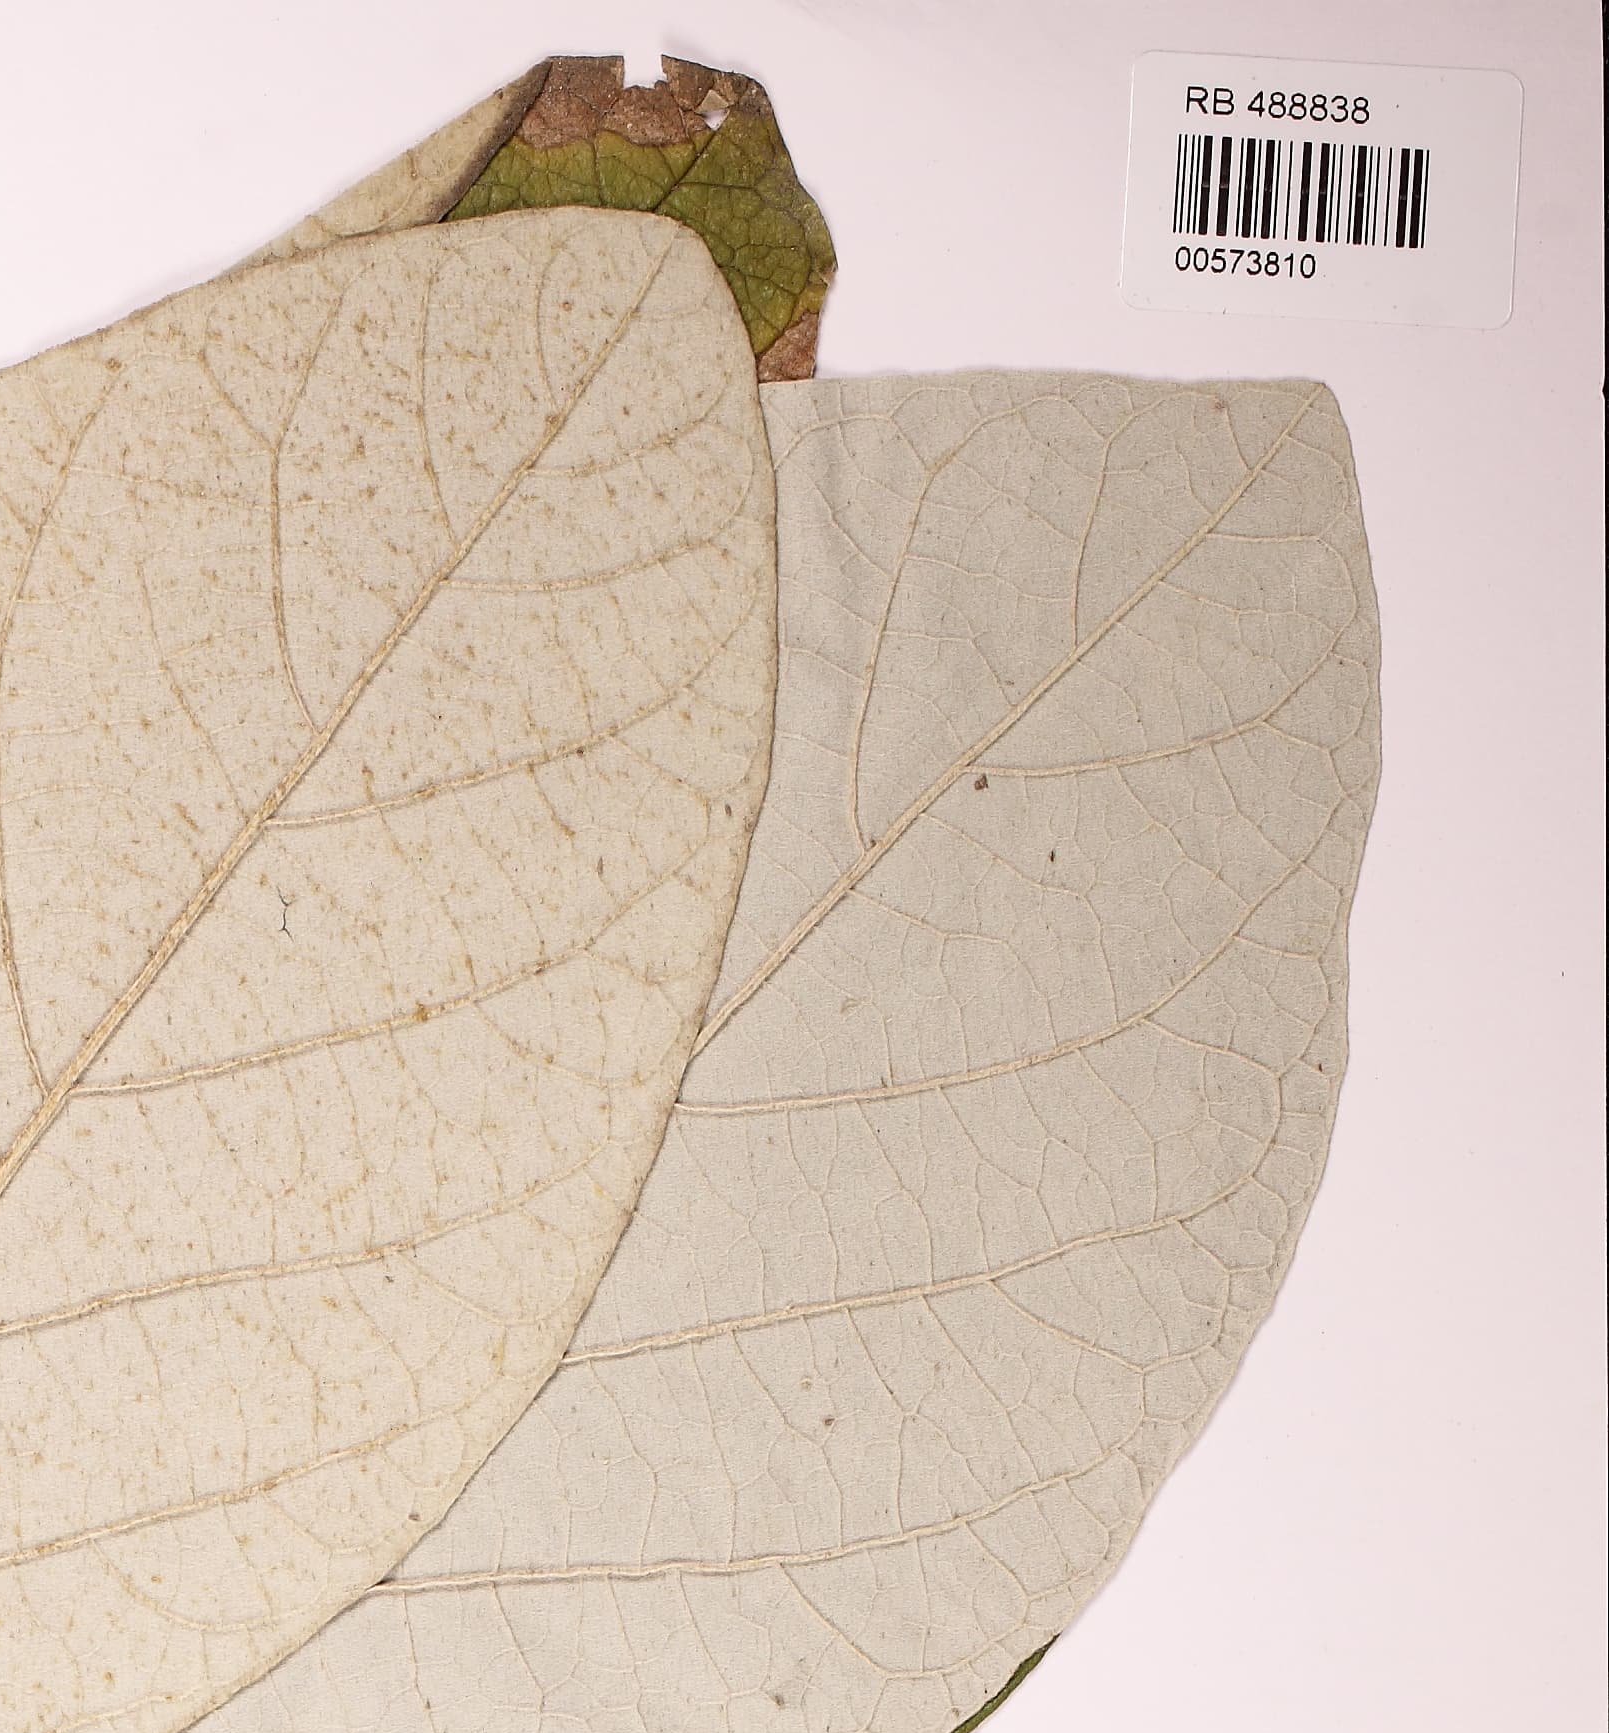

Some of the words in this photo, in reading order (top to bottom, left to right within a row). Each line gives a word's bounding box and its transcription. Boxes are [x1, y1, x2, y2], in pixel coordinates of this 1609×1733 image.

[1184, 84, 1236, 117] RB
[1246, 90, 1372, 125] 488838
[1173, 245, 1318, 280] 00573810
